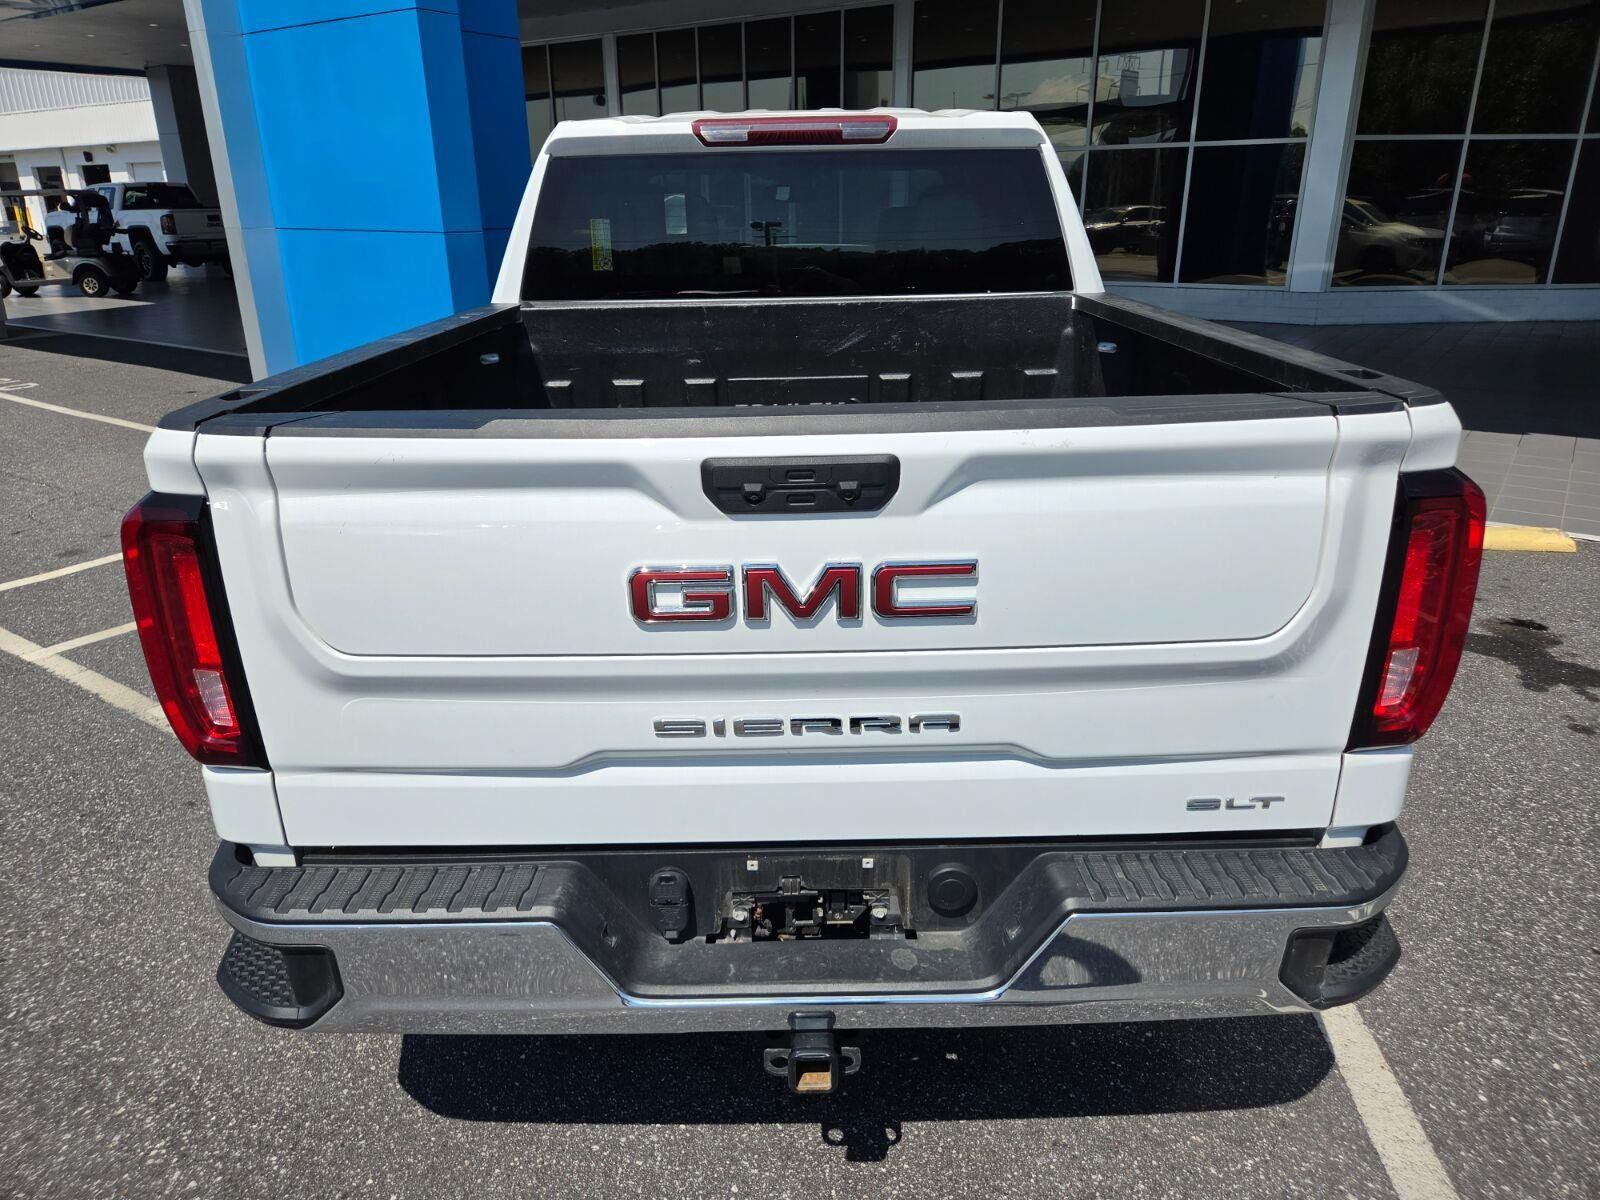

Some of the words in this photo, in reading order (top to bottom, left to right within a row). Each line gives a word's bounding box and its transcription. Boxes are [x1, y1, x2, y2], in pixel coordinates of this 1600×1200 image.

[627, 559, 979, 625] GMC
[653, 713, 961, 738] SIERRA
[1186, 796, 1285, 811] SLT
